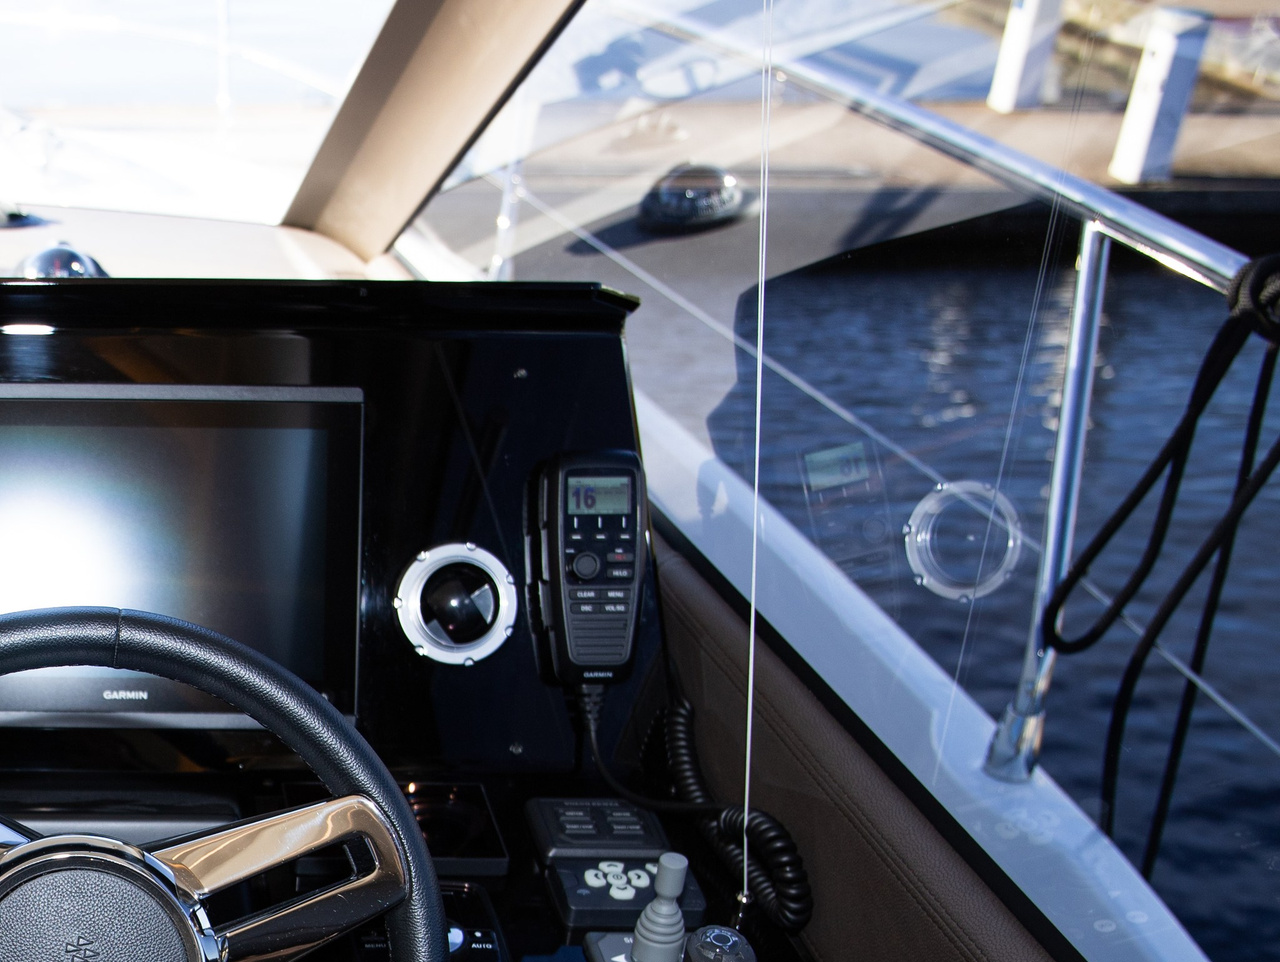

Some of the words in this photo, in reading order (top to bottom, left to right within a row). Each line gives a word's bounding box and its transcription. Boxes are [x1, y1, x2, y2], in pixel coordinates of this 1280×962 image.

[572, 486, 596, 510] 16
[583, 671, 613, 679] GARMIN
[103, 690, 149, 701] GARMIN
